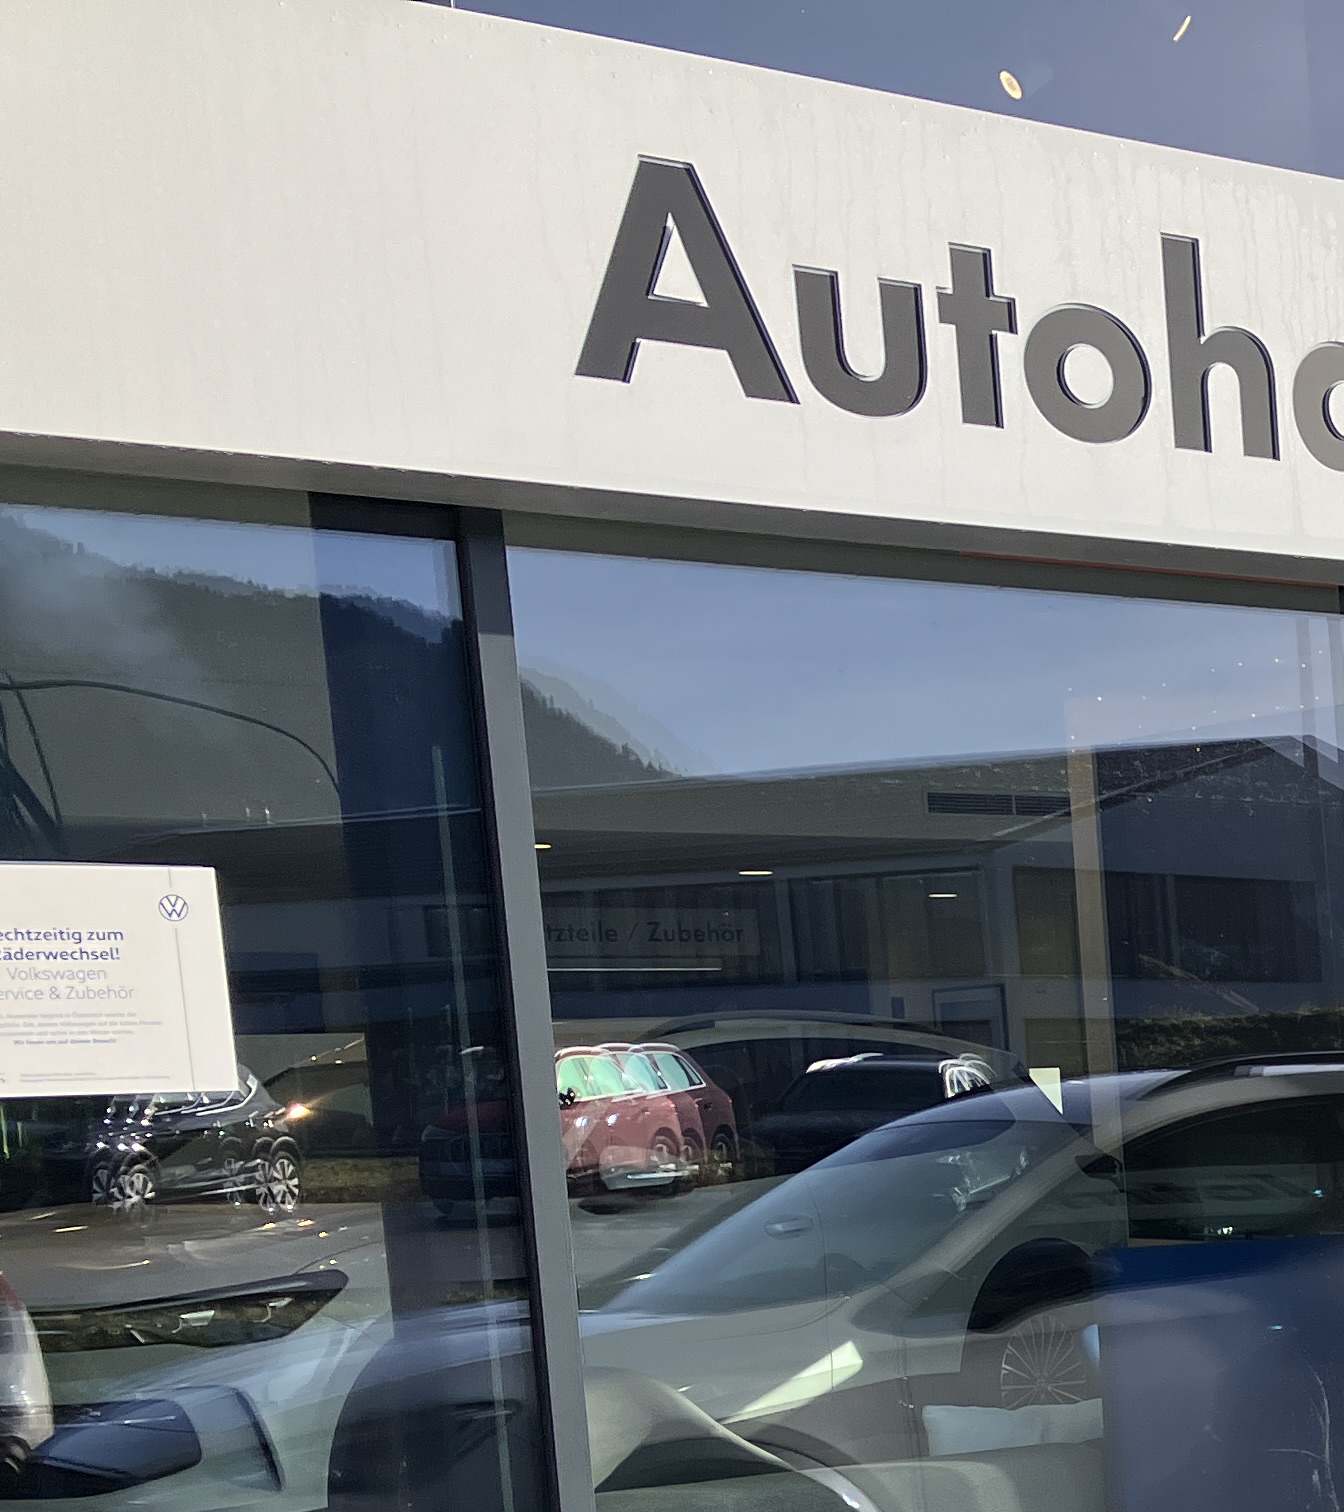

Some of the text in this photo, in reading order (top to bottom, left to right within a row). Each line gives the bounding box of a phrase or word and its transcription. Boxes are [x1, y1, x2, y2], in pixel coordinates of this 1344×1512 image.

[86, 931, 124, 941] zum
[647, 921, 744, 943] Zubehör
[0, 947, 121, 961] äderwechsel!
[6, 966, 107, 983] Volkswagen
[49, 986, 61, 1000] &
[65, 985, 135, 1000] Zubehör
